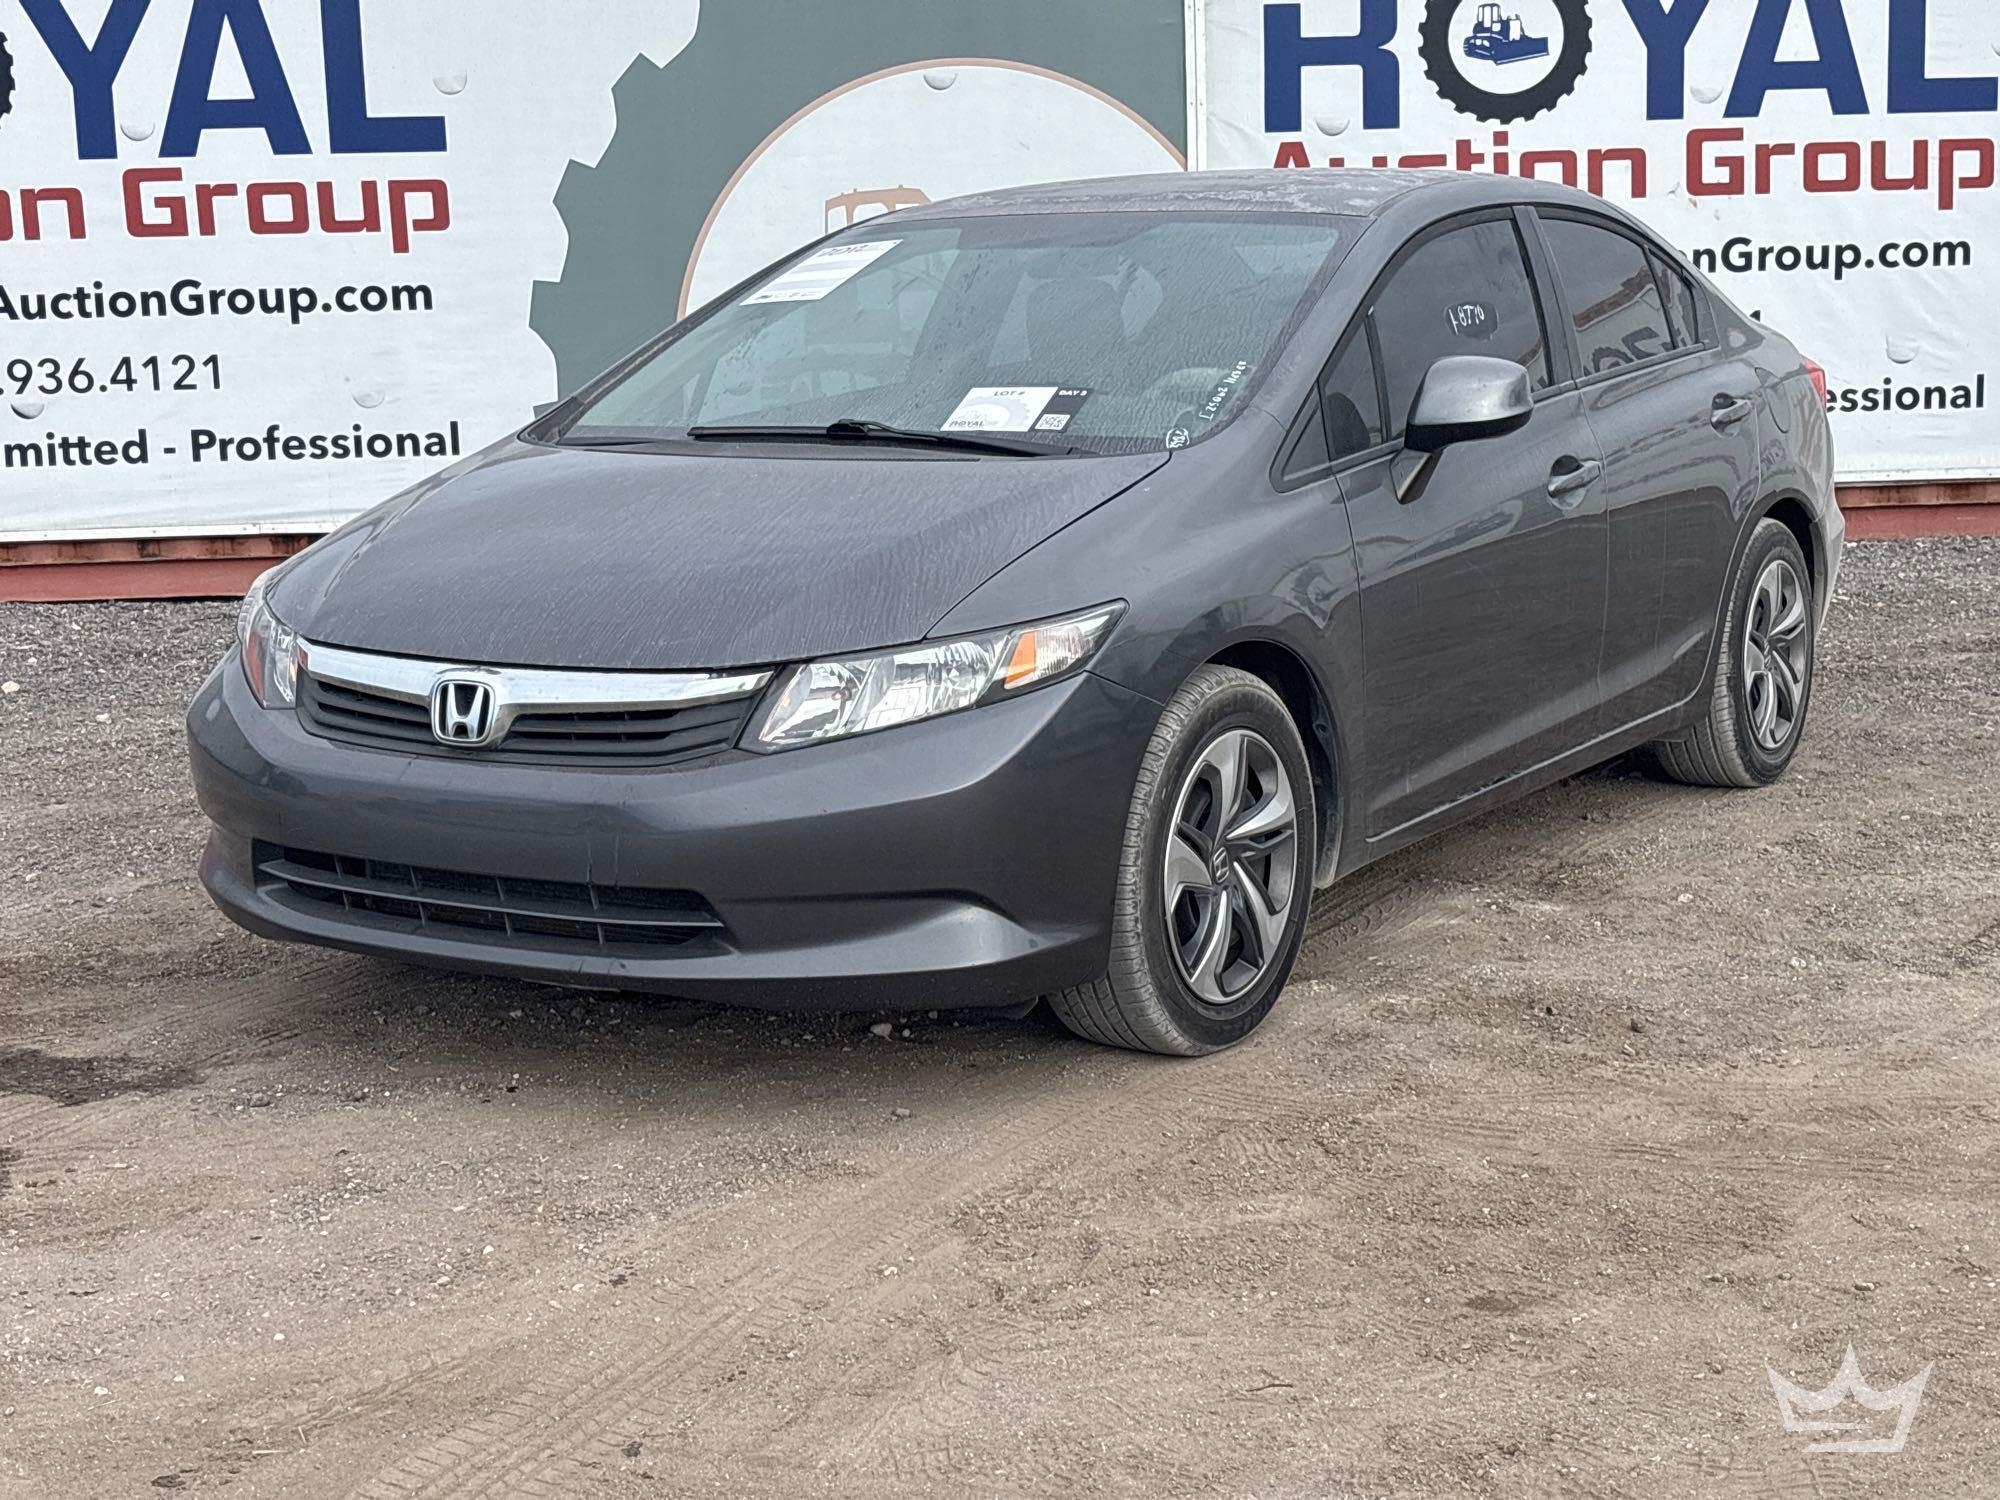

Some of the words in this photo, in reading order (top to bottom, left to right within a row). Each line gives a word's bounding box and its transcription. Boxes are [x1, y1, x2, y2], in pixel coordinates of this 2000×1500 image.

[0, 0, 447, 160] YAL
[1686, 128, 1995, 210] Group
[122, 167, 451, 254] Group
[1678, 237, 1971, 280] nGroup.com
[0, 279, 433, 325] AuctionGroup.com
[4, 428, 149, 468] mitted
[191, 420, 460, 463] Professional
